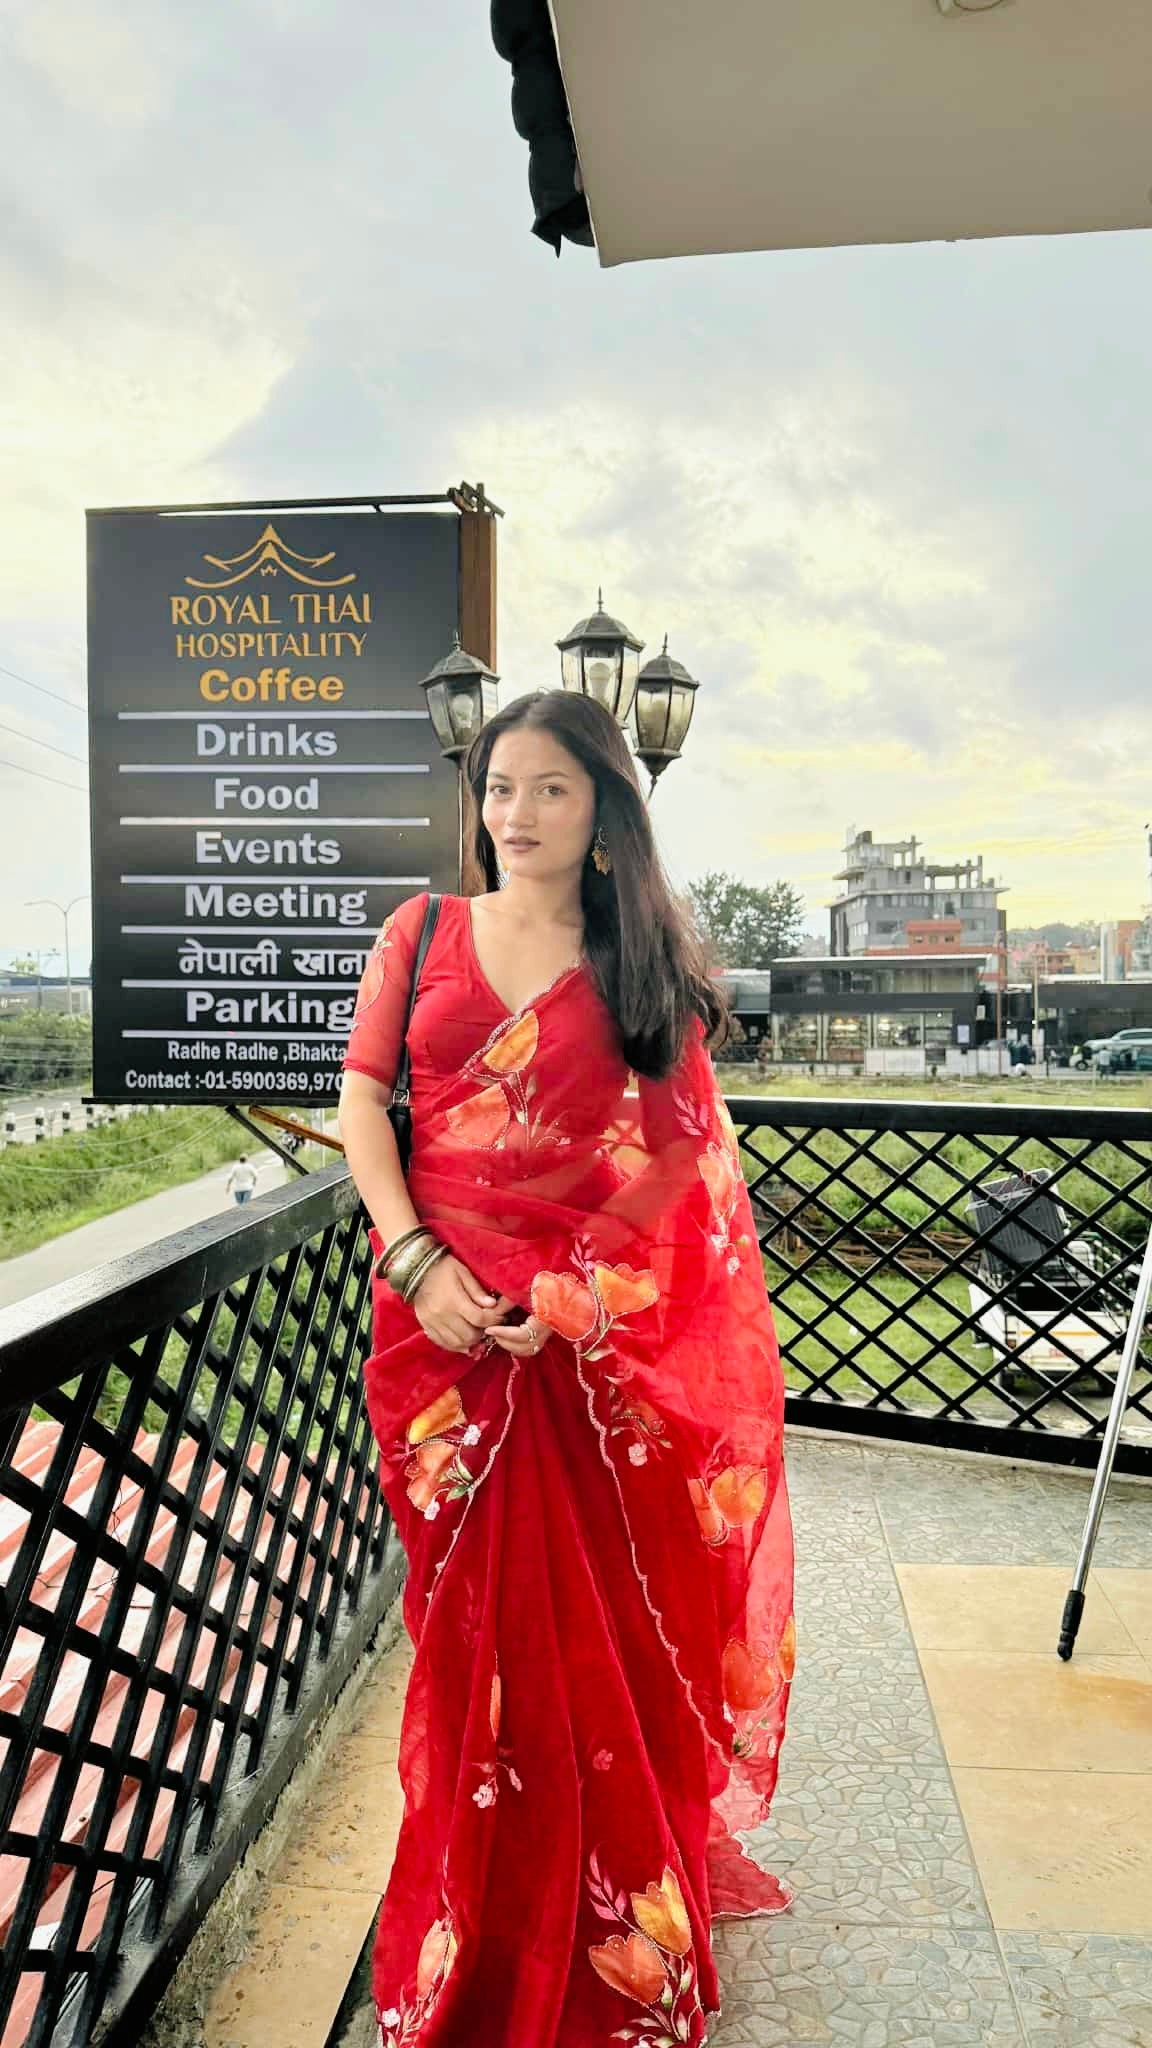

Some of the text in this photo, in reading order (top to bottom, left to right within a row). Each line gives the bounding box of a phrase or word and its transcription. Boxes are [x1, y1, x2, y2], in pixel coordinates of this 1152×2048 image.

[169, 592, 372, 626] ROYAL THAI
[175, 631, 368, 658] HOSPITALITY
[199, 667, 345, 702] Coffee
[196, 722, 338, 757] Drinks
[214, 777, 320, 811] Food
[195, 831, 341, 865] Events
[184, 884, 368, 926] Meeting
[178, 938, 281, 976] नेपाली
[186, 991, 355, 1032] Parking
[167, 1040, 221, 1060] Radhe
[225, 1041, 279, 1061] Radhe
[125, 1070, 191, 1089] Contact
